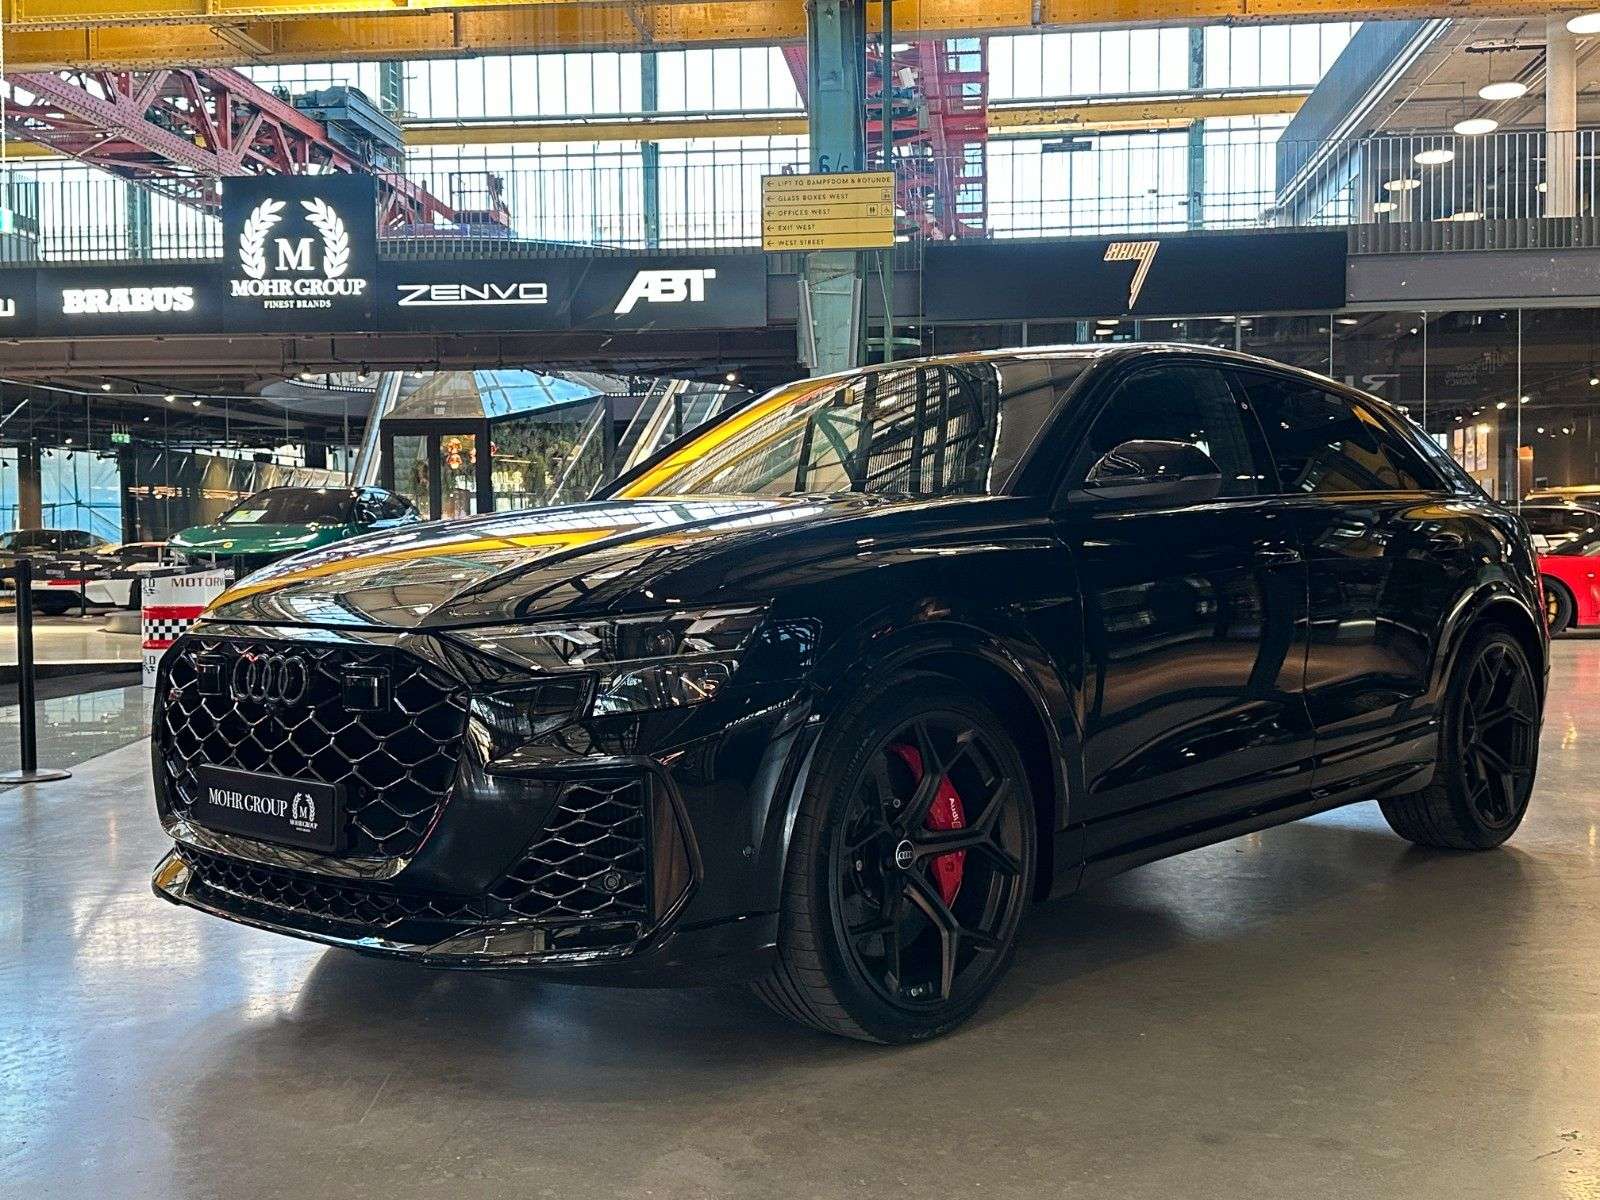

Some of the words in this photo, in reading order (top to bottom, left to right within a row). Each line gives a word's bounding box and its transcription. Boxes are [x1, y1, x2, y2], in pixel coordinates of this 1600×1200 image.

[777, 180, 793, 188] LIFT
[806, 178, 849, 186] DAMPFDOM
[857, 176, 891, 184] ROTUNDE
[802, 193, 826, 201] BOXES
[777, 209, 809, 217] OFFICES
[811, 208, 831, 216] WEST
[274, 237, 316, 271] M
[230, 279, 295, 297] MOHR
[294, 278, 367, 296] GROUP
[397, 282, 548, 306] ZENVO
[614, 268, 717, 314] ABT
[62, 286, 195, 315] BRABUS
[263, 299, 295, 309] FINEST
[296, 299, 332, 309] BRANDS
[208, 787, 244, 811] MOHR
[244, 794, 288, 817] GROUP
[948, 797, 960, 822] Audi
